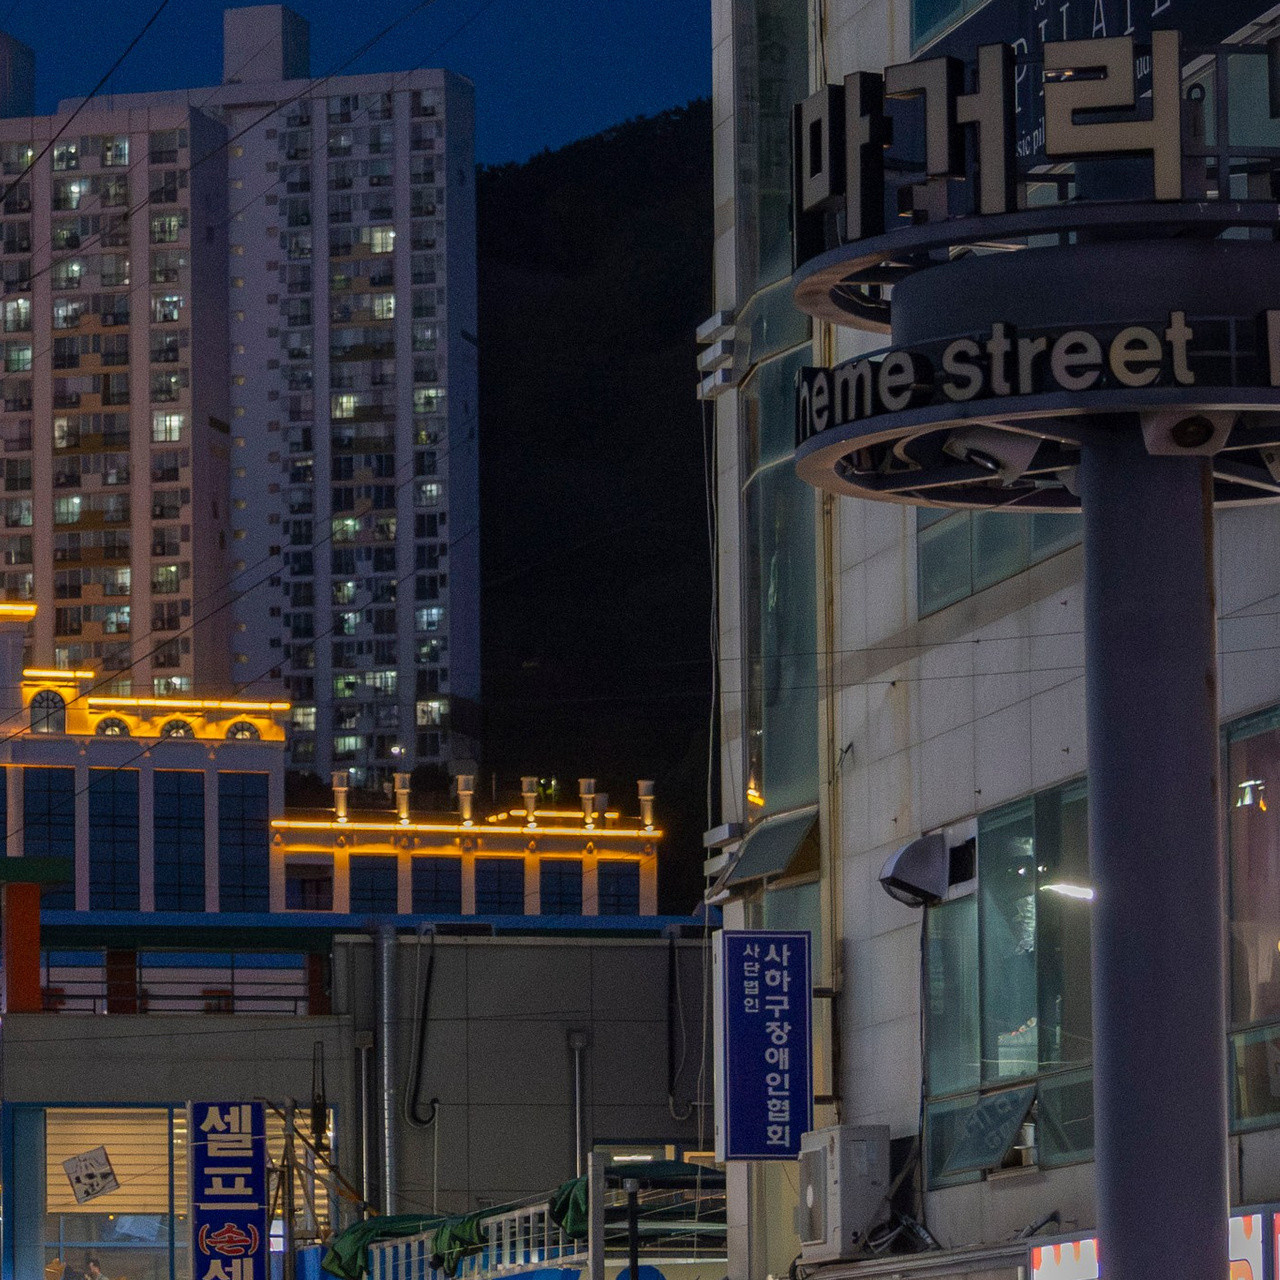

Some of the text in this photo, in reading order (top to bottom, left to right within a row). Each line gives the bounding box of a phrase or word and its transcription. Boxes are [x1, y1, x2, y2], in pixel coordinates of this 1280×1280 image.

[941, 310, 1195, 402] street
[742, 942, 761, 1014] 사단법인
[764, 942, 792, 1148] 사하구장애인협회
